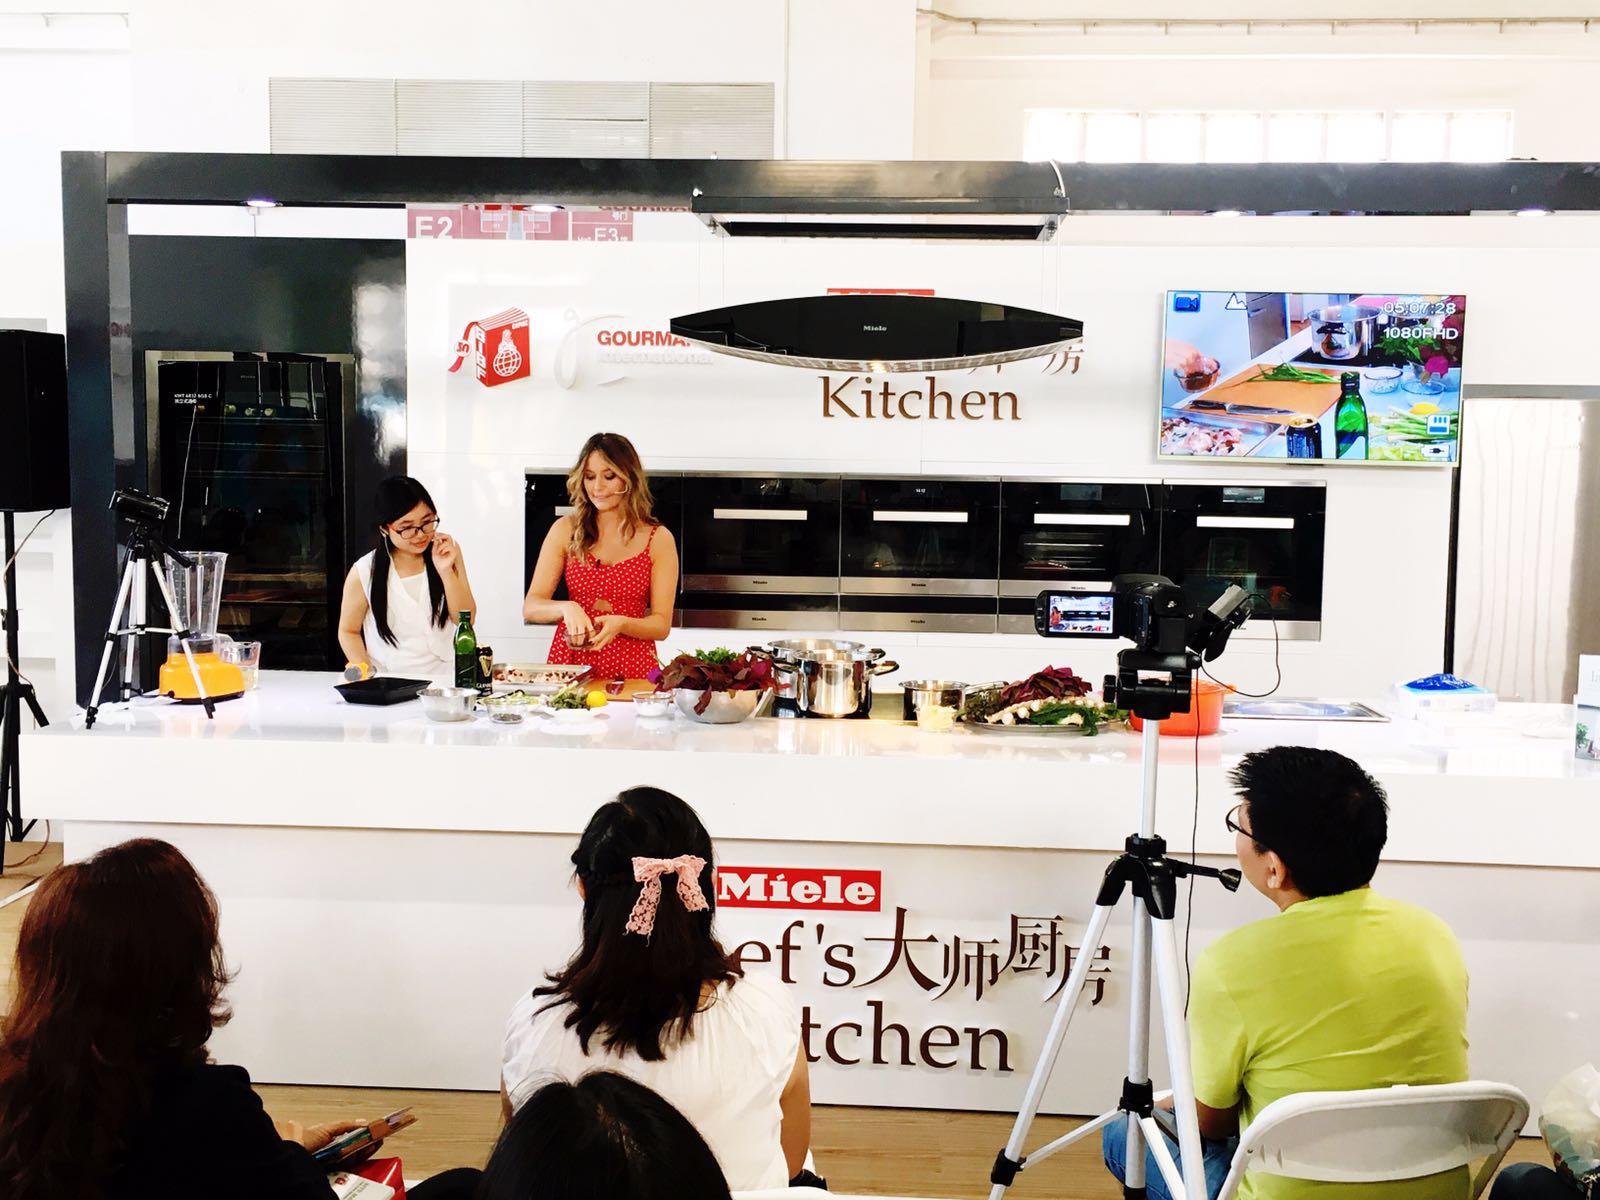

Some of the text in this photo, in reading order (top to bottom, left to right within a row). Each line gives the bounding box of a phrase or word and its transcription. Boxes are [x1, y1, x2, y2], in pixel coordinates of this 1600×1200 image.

[415, 216, 453, 240] E2
[594, 227, 619, 241] E3
[1384, 302, 1457, 315] 05:07:28
[597, 330, 691, 347] GOURMA
[1383, 327, 1459, 340] 1080FHD
[818, 375, 1022, 421] Kitchen
[718, 872, 876, 905] Miele
[734, 906, 1111, 1006] ef's 大师厨房
[801, 1001, 1015, 1072] tchen
